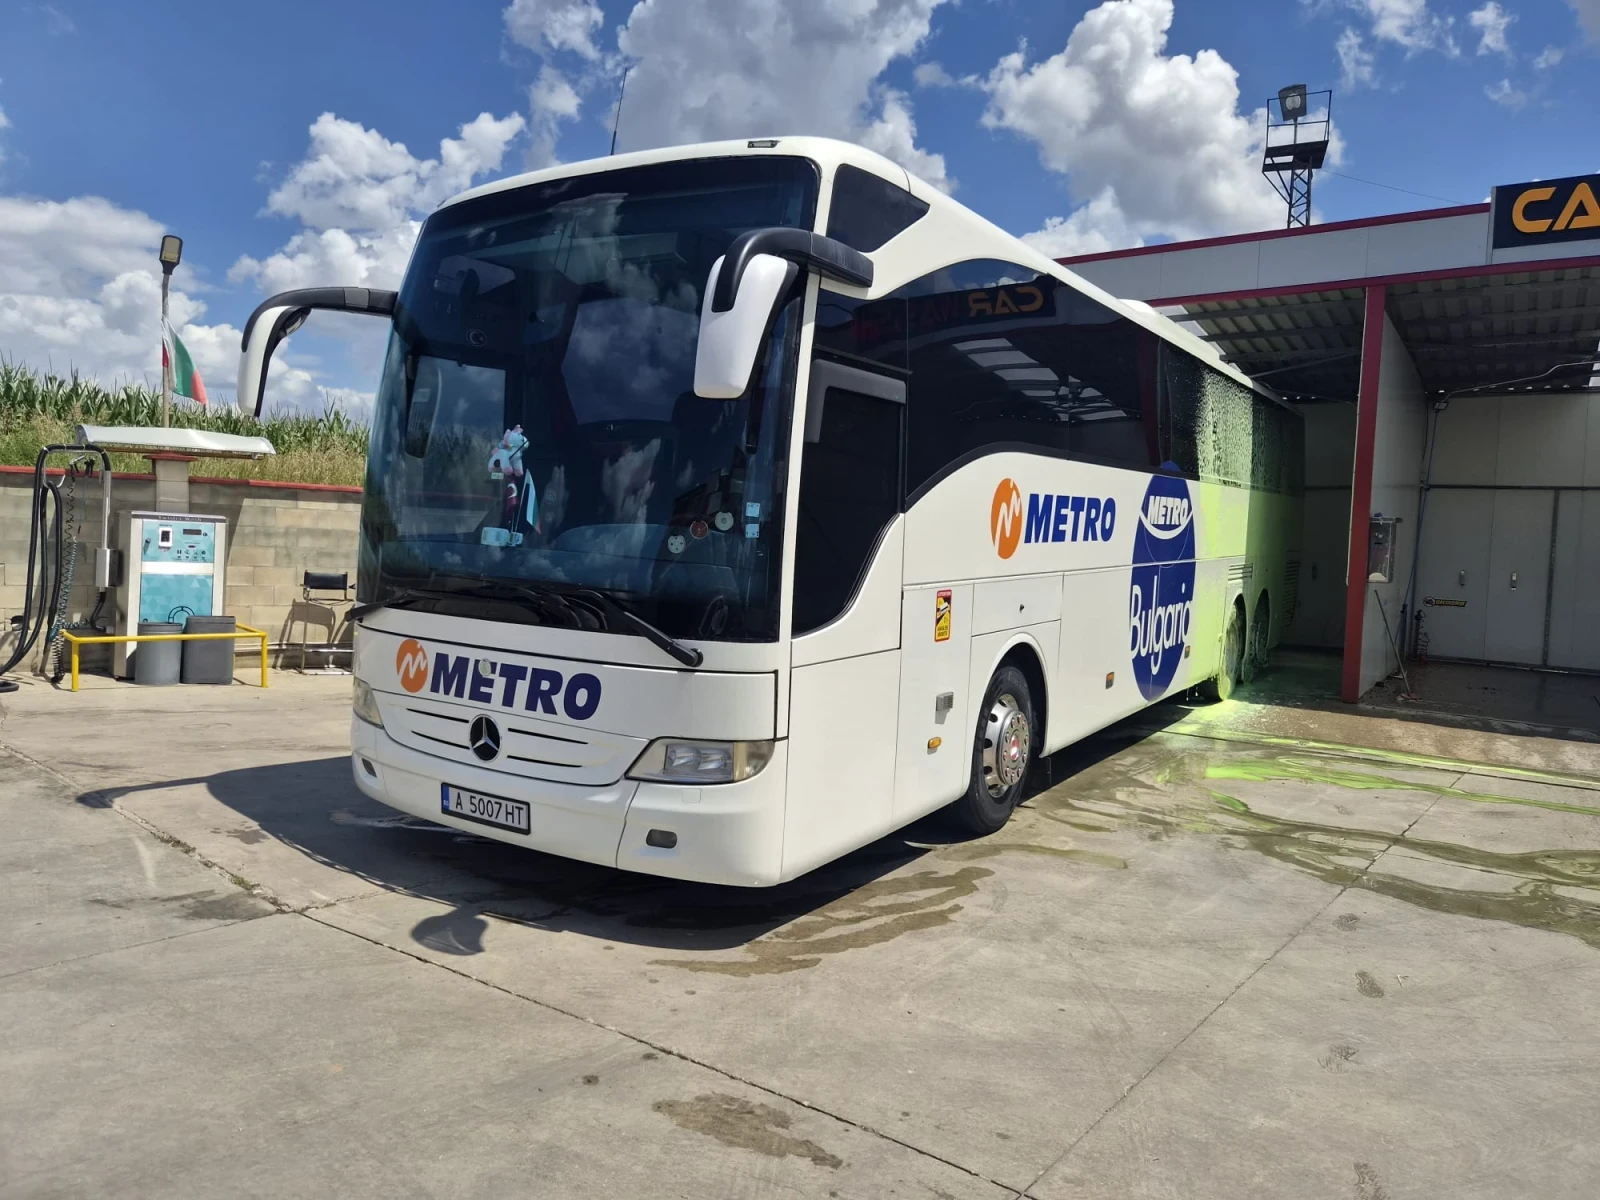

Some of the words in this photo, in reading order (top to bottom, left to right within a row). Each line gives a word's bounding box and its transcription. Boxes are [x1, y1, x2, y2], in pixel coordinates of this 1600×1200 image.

[1024, 493, 1116, 543] METRO
[1147, 495, 1188, 525] METRO
[1130, 575, 1191, 675] Bulgaria
[430, 652, 602, 721] METRO
[455, 792, 463, 811] A
[469, 795, 503, 820] 5007
[505, 804, 524, 826] HT
